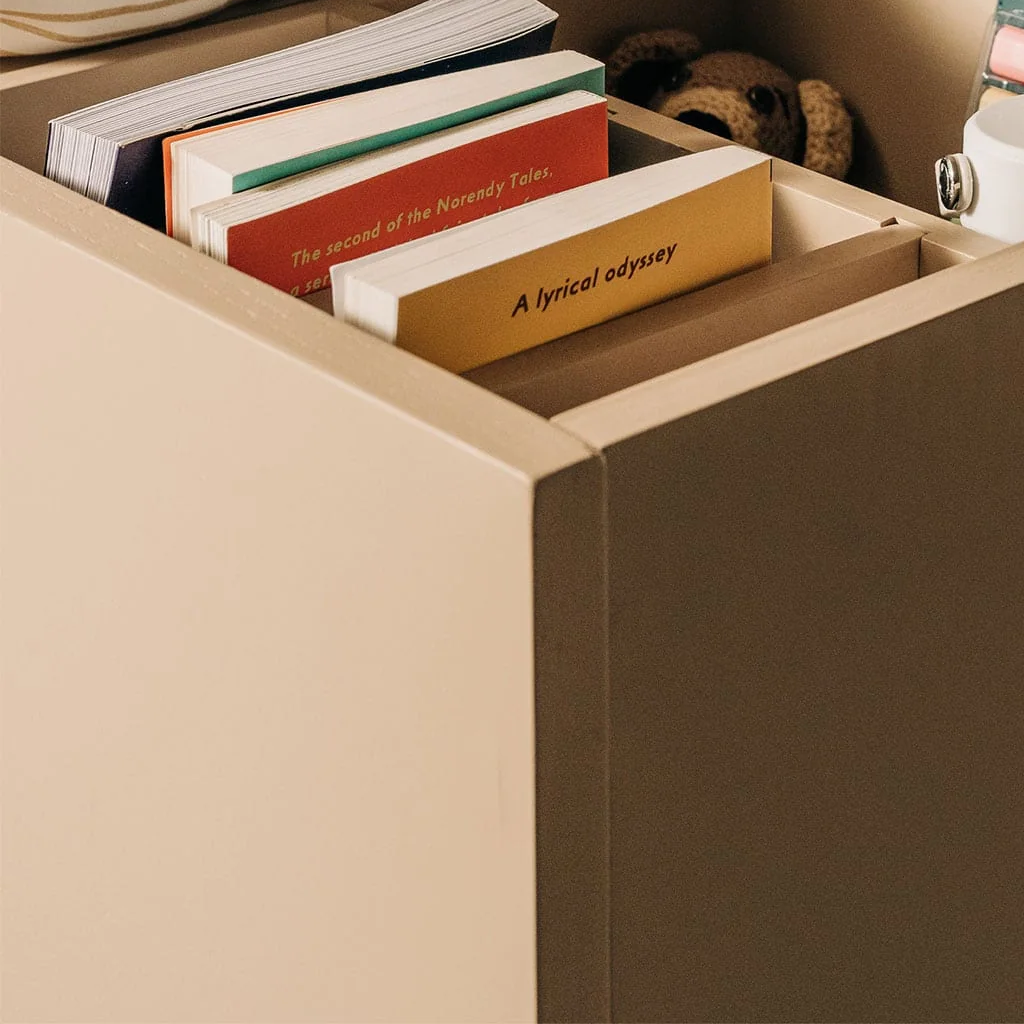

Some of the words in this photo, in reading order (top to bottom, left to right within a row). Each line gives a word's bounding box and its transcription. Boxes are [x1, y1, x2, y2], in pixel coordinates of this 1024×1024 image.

[291, 249, 321, 268] The
[325, 221, 381, 256] second
[386, 212, 404, 233] of
[407, 207, 432, 226] the
[436, 180, 506, 215] Norendy
[510, 167, 553, 189] Tales,
[511, 293, 529, 318] A
[536, 267, 600, 313] lyrical
[605, 243, 678, 280] odyssey
